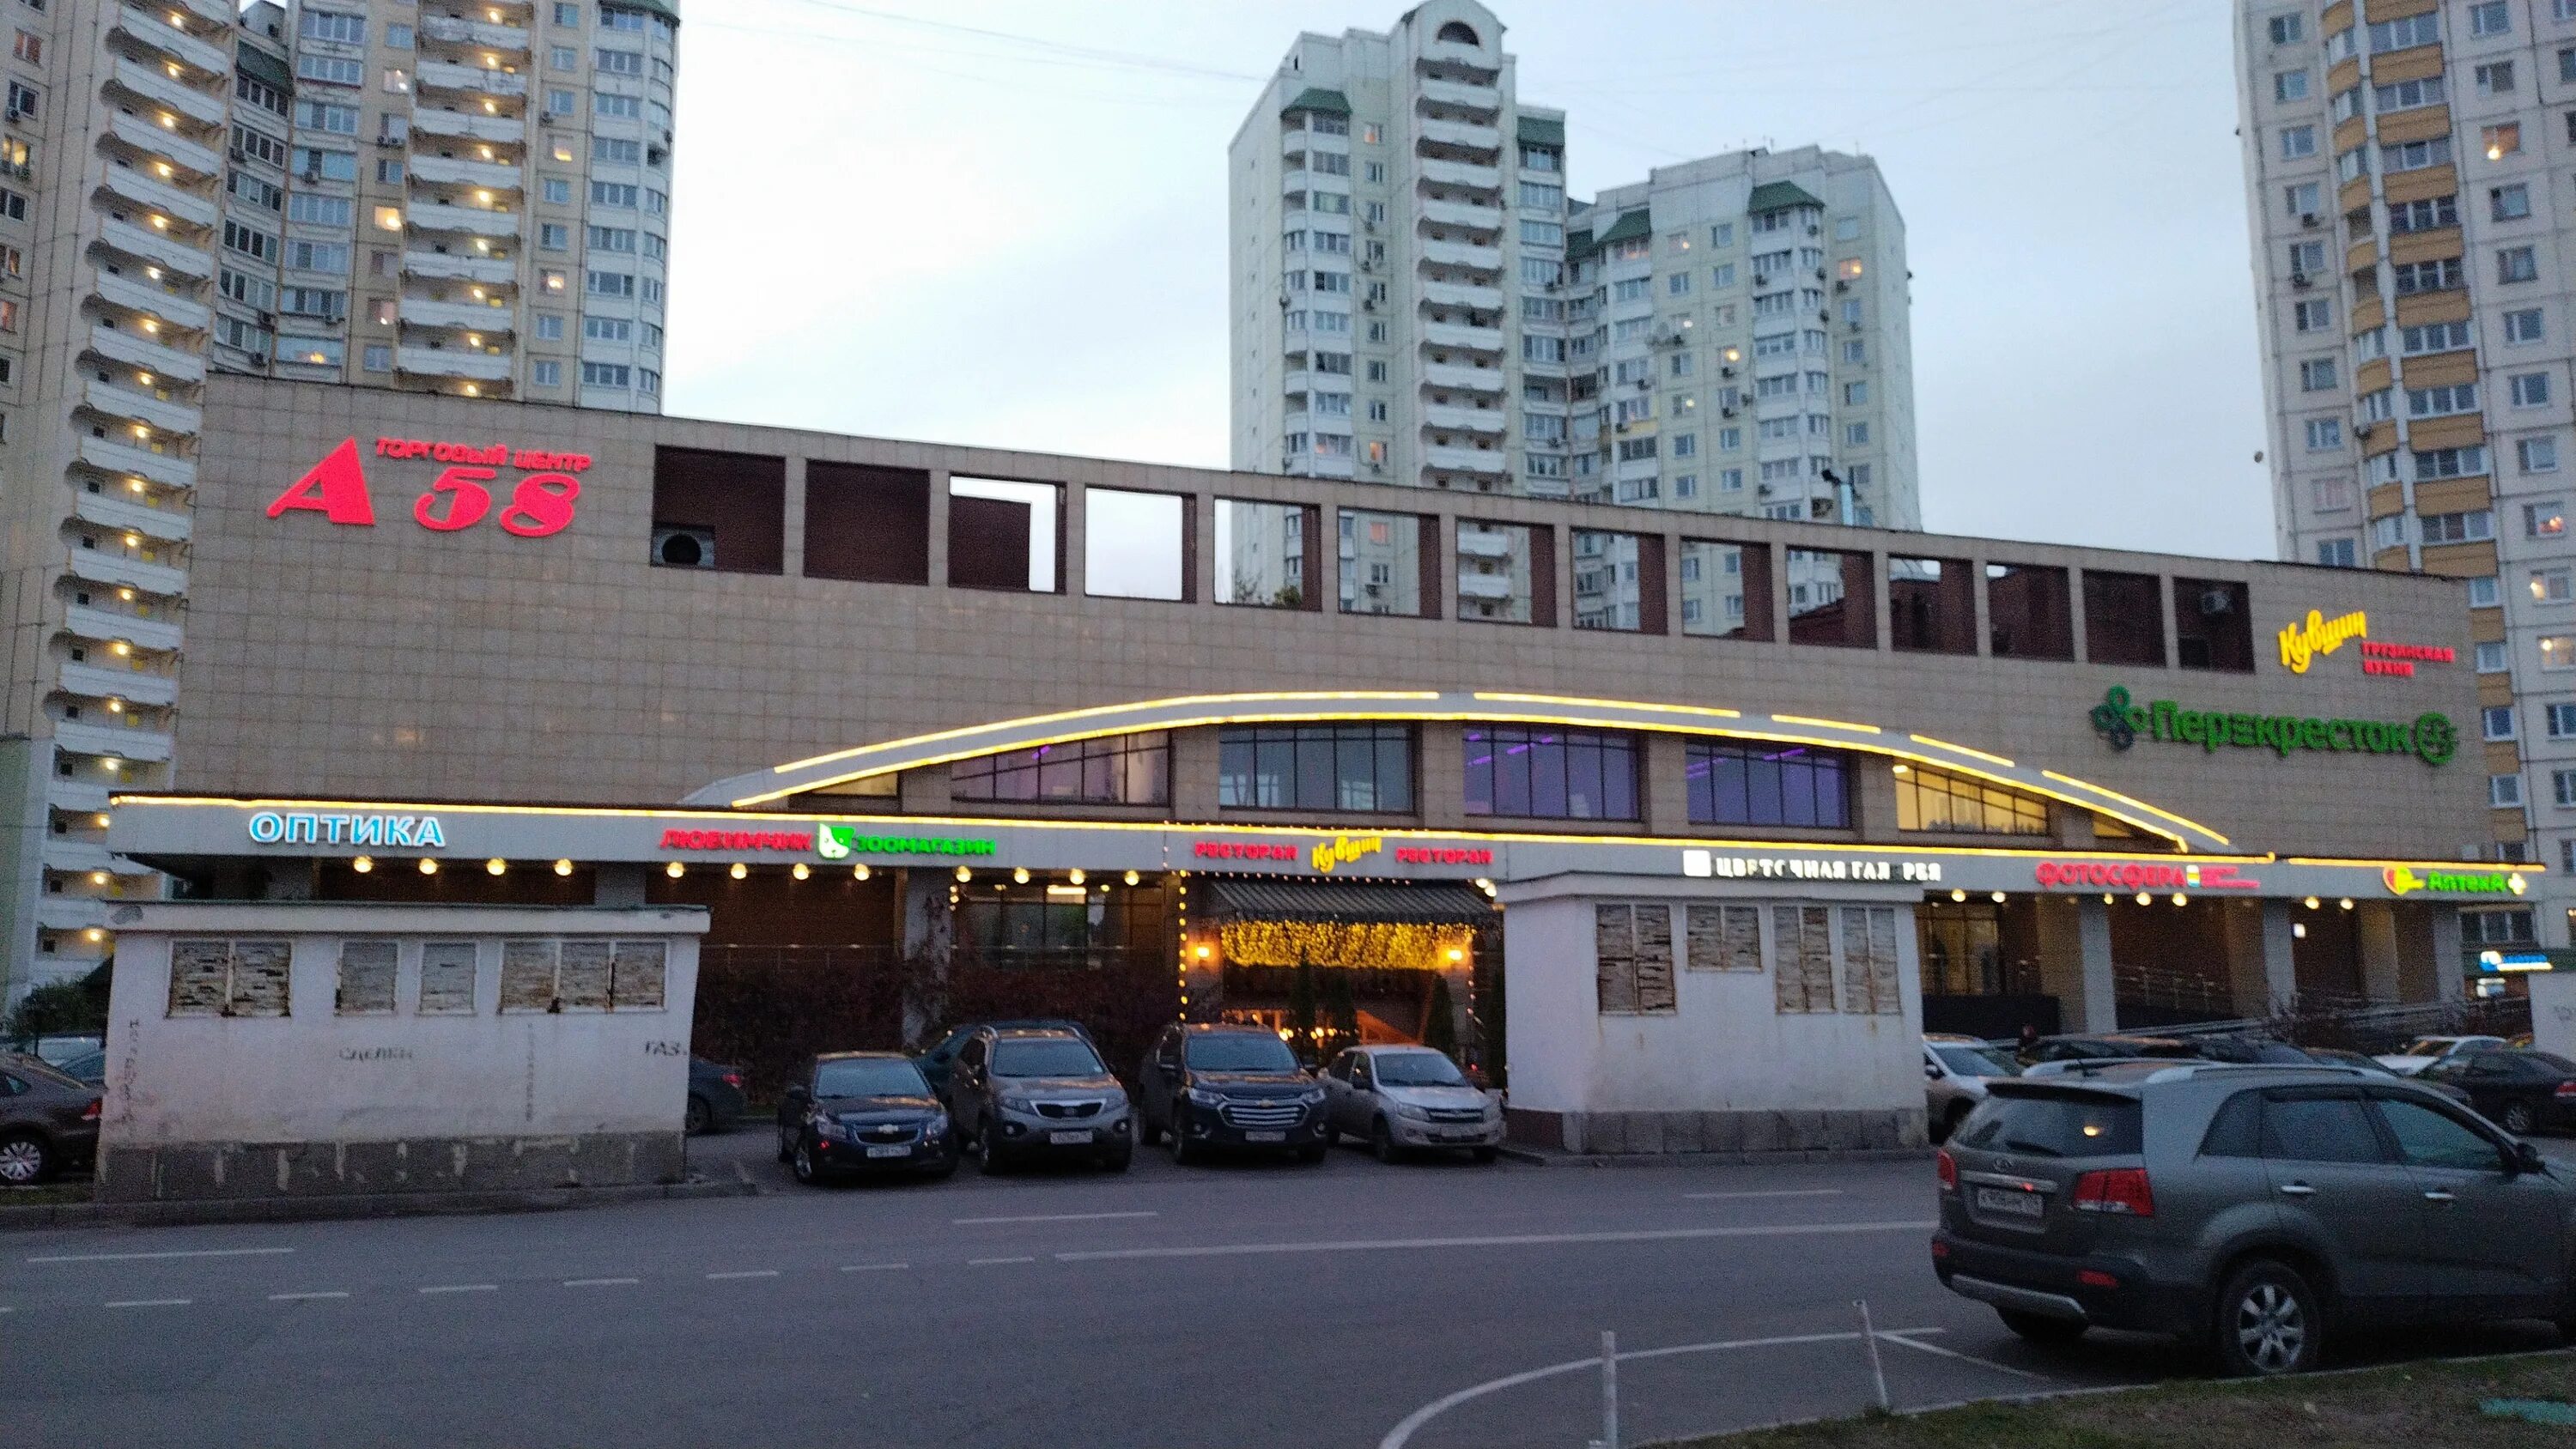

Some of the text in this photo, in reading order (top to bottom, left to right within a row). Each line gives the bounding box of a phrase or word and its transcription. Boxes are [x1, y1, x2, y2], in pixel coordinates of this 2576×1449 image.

[376, 437, 592, 471] ТОРГОВЫЙ ЦЕНТР
[2277, 609, 2366, 674] Кувшин
[2151, 700, 2411, 756] Перекресток
[249, 812, 445, 847] ОПТИКА
[857, 833, 997, 856] ЗООМАГАЗИН
[1194, 841, 1299, 860] РЕСТОРАН
[1395, 846, 1494, 865] РЕСТОРАН
[1850, 860, 1941, 882] ГАЛРЕЯ
[2036, 861, 2187, 891] ФОТОСФЕРА
